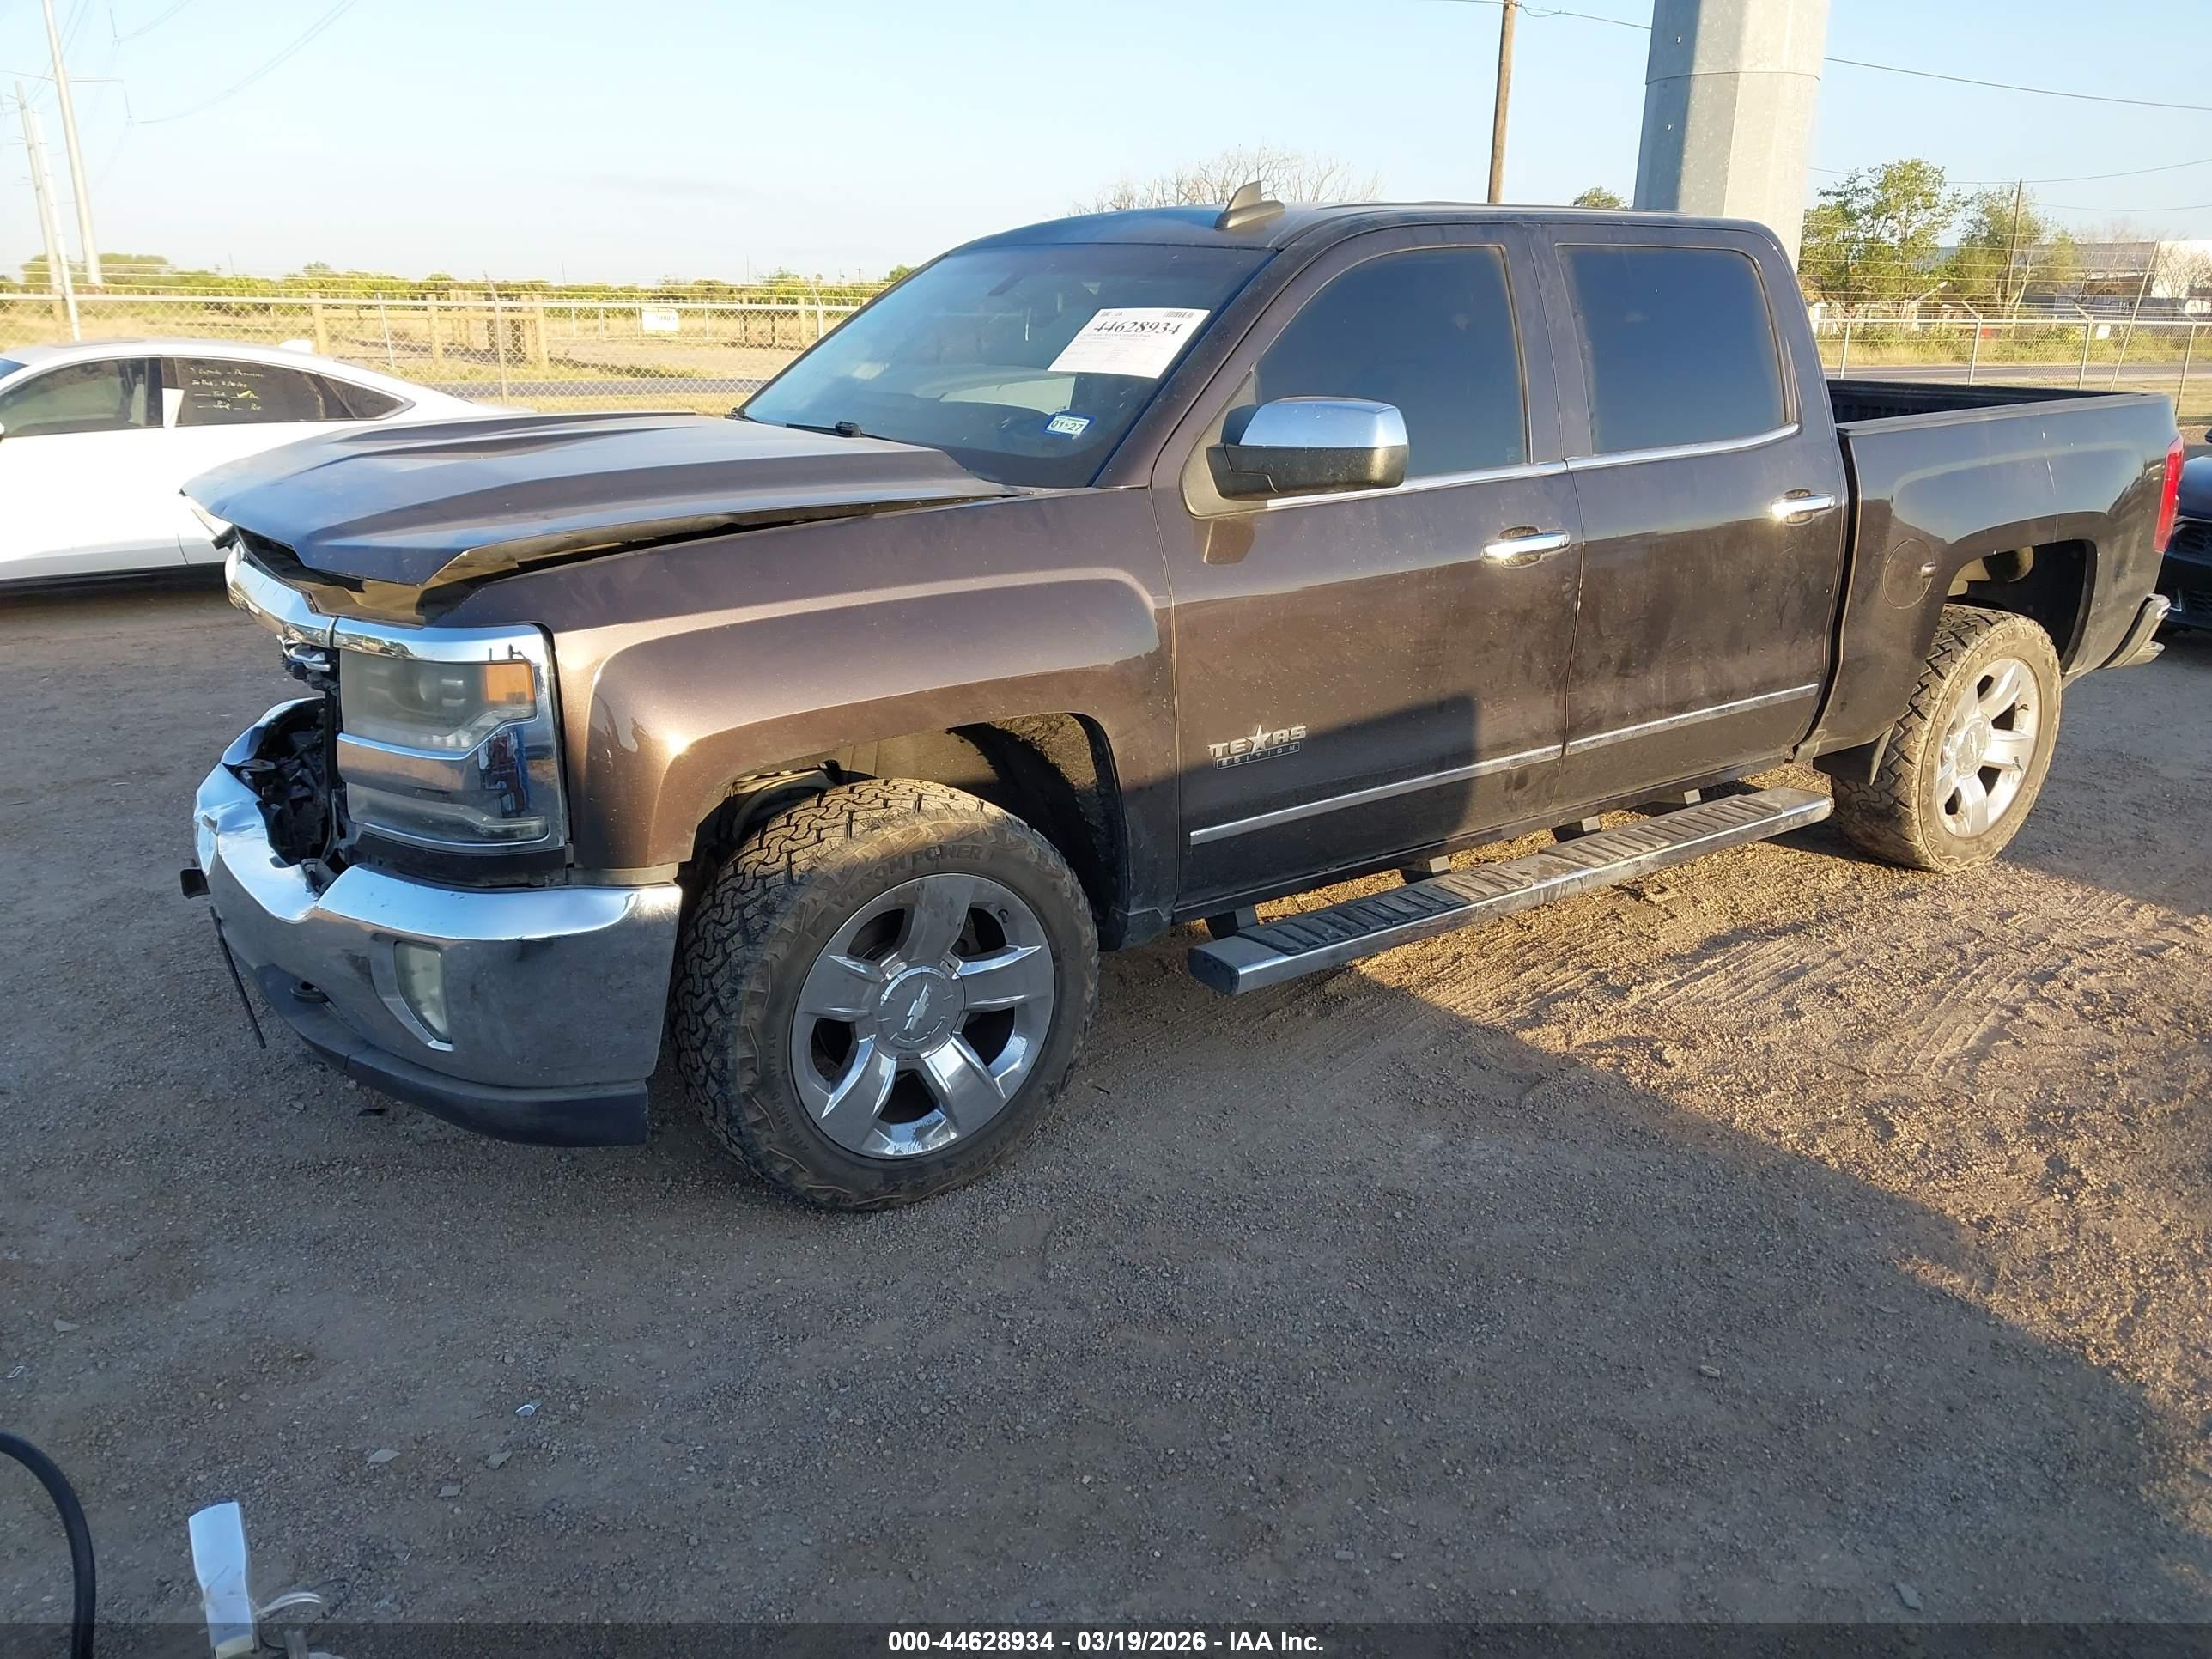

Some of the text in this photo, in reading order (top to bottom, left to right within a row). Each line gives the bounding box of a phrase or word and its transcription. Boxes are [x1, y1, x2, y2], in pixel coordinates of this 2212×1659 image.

[1093, 320, 1182, 335] 44628934
[1207, 723, 1307, 757] TEXAS
[1221, 744, 1297, 766] EDITION
[912, 843, 983, 865] POWER
